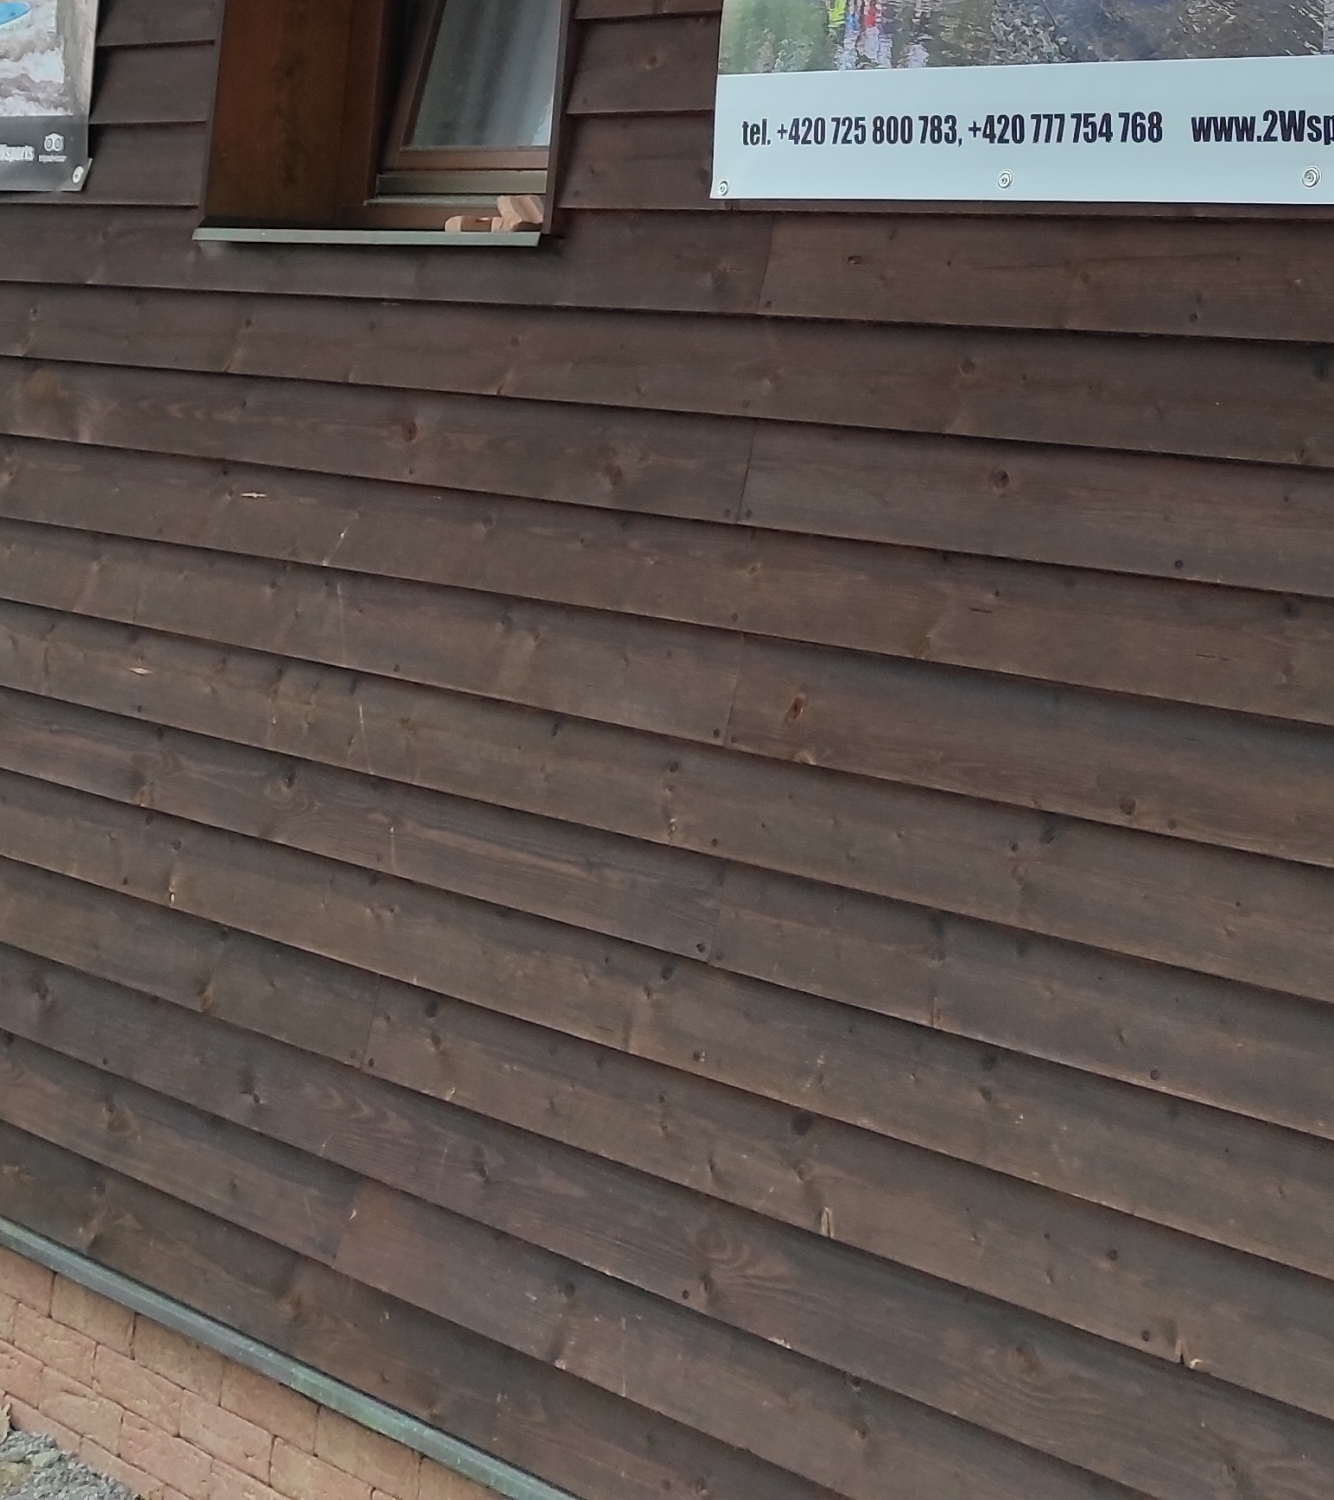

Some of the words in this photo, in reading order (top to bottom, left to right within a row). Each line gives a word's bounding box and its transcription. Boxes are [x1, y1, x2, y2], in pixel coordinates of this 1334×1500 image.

[742, 118, 771, 146] tel.
[777, 116, 826, 145] +420
[831, 116, 867, 145] 725
[872, 115, 913, 144] 800
[918, 114, 963, 147] 783,
[968, 113, 1025, 144] +420
[1030, 113, 1065, 144] 777
[1070, 112, 1114, 144] 754
[1118, 111, 1163, 143] 768
